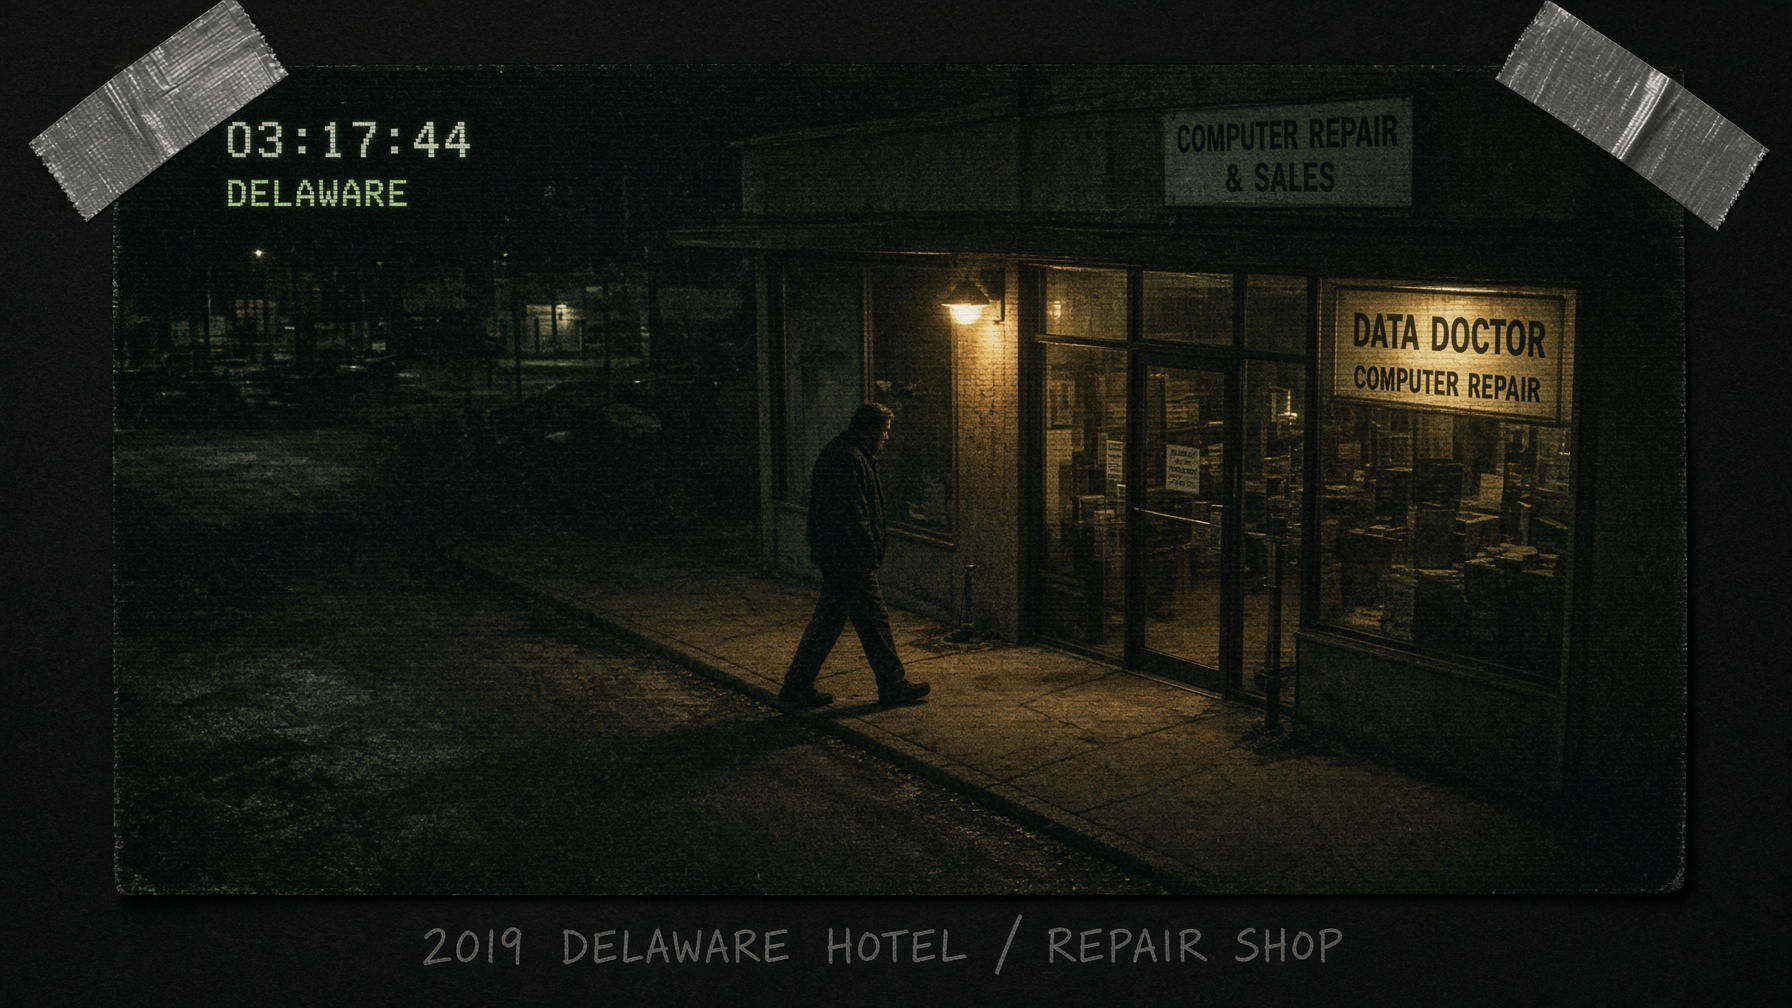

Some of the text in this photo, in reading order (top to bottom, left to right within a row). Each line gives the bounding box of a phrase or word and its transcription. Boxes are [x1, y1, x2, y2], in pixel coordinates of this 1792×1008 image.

[1177, 115, 1399, 153] COMPUTER REPAIR
[1225, 161, 1336, 193] & SALES
[1353, 312, 1546, 359] DATA DOCTOR
[1354, 365, 1541, 403] COMPUTER REPAIR
[422, 913, 1344, 976] 2019 DELAWARE HOTEL / REPAIR SHOP
